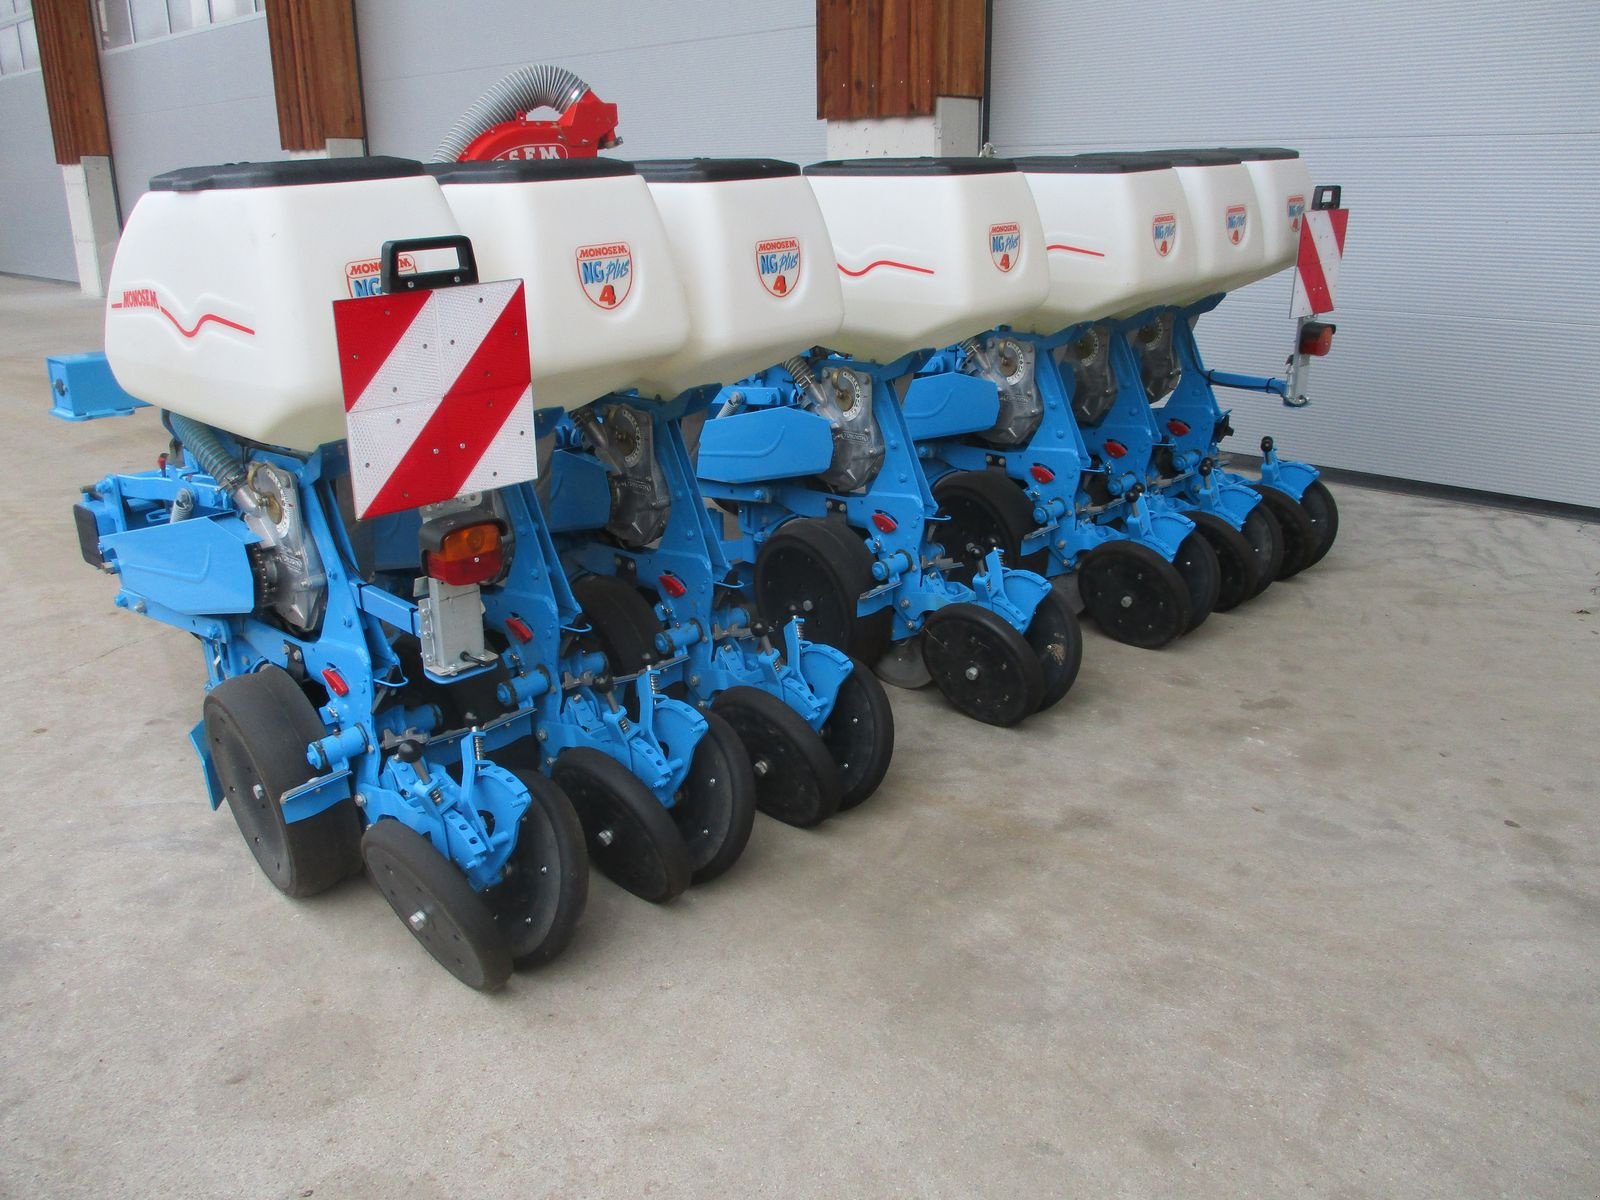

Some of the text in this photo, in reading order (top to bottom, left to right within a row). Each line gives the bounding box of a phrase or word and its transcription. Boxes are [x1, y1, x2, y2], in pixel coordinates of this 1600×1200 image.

[579, 244, 628, 259] MONOSEM
[758, 239, 797, 251] MONOSEM
[992, 235, 1005, 253] NG
[760, 253, 778, 275] NG
[1000, 253, 1010, 270] 4
[581, 260, 605, 285] NG
[773, 275, 787, 294] 4
[123, 288, 159, 310] MONOSEM
[599, 284, 617, 306] 4
